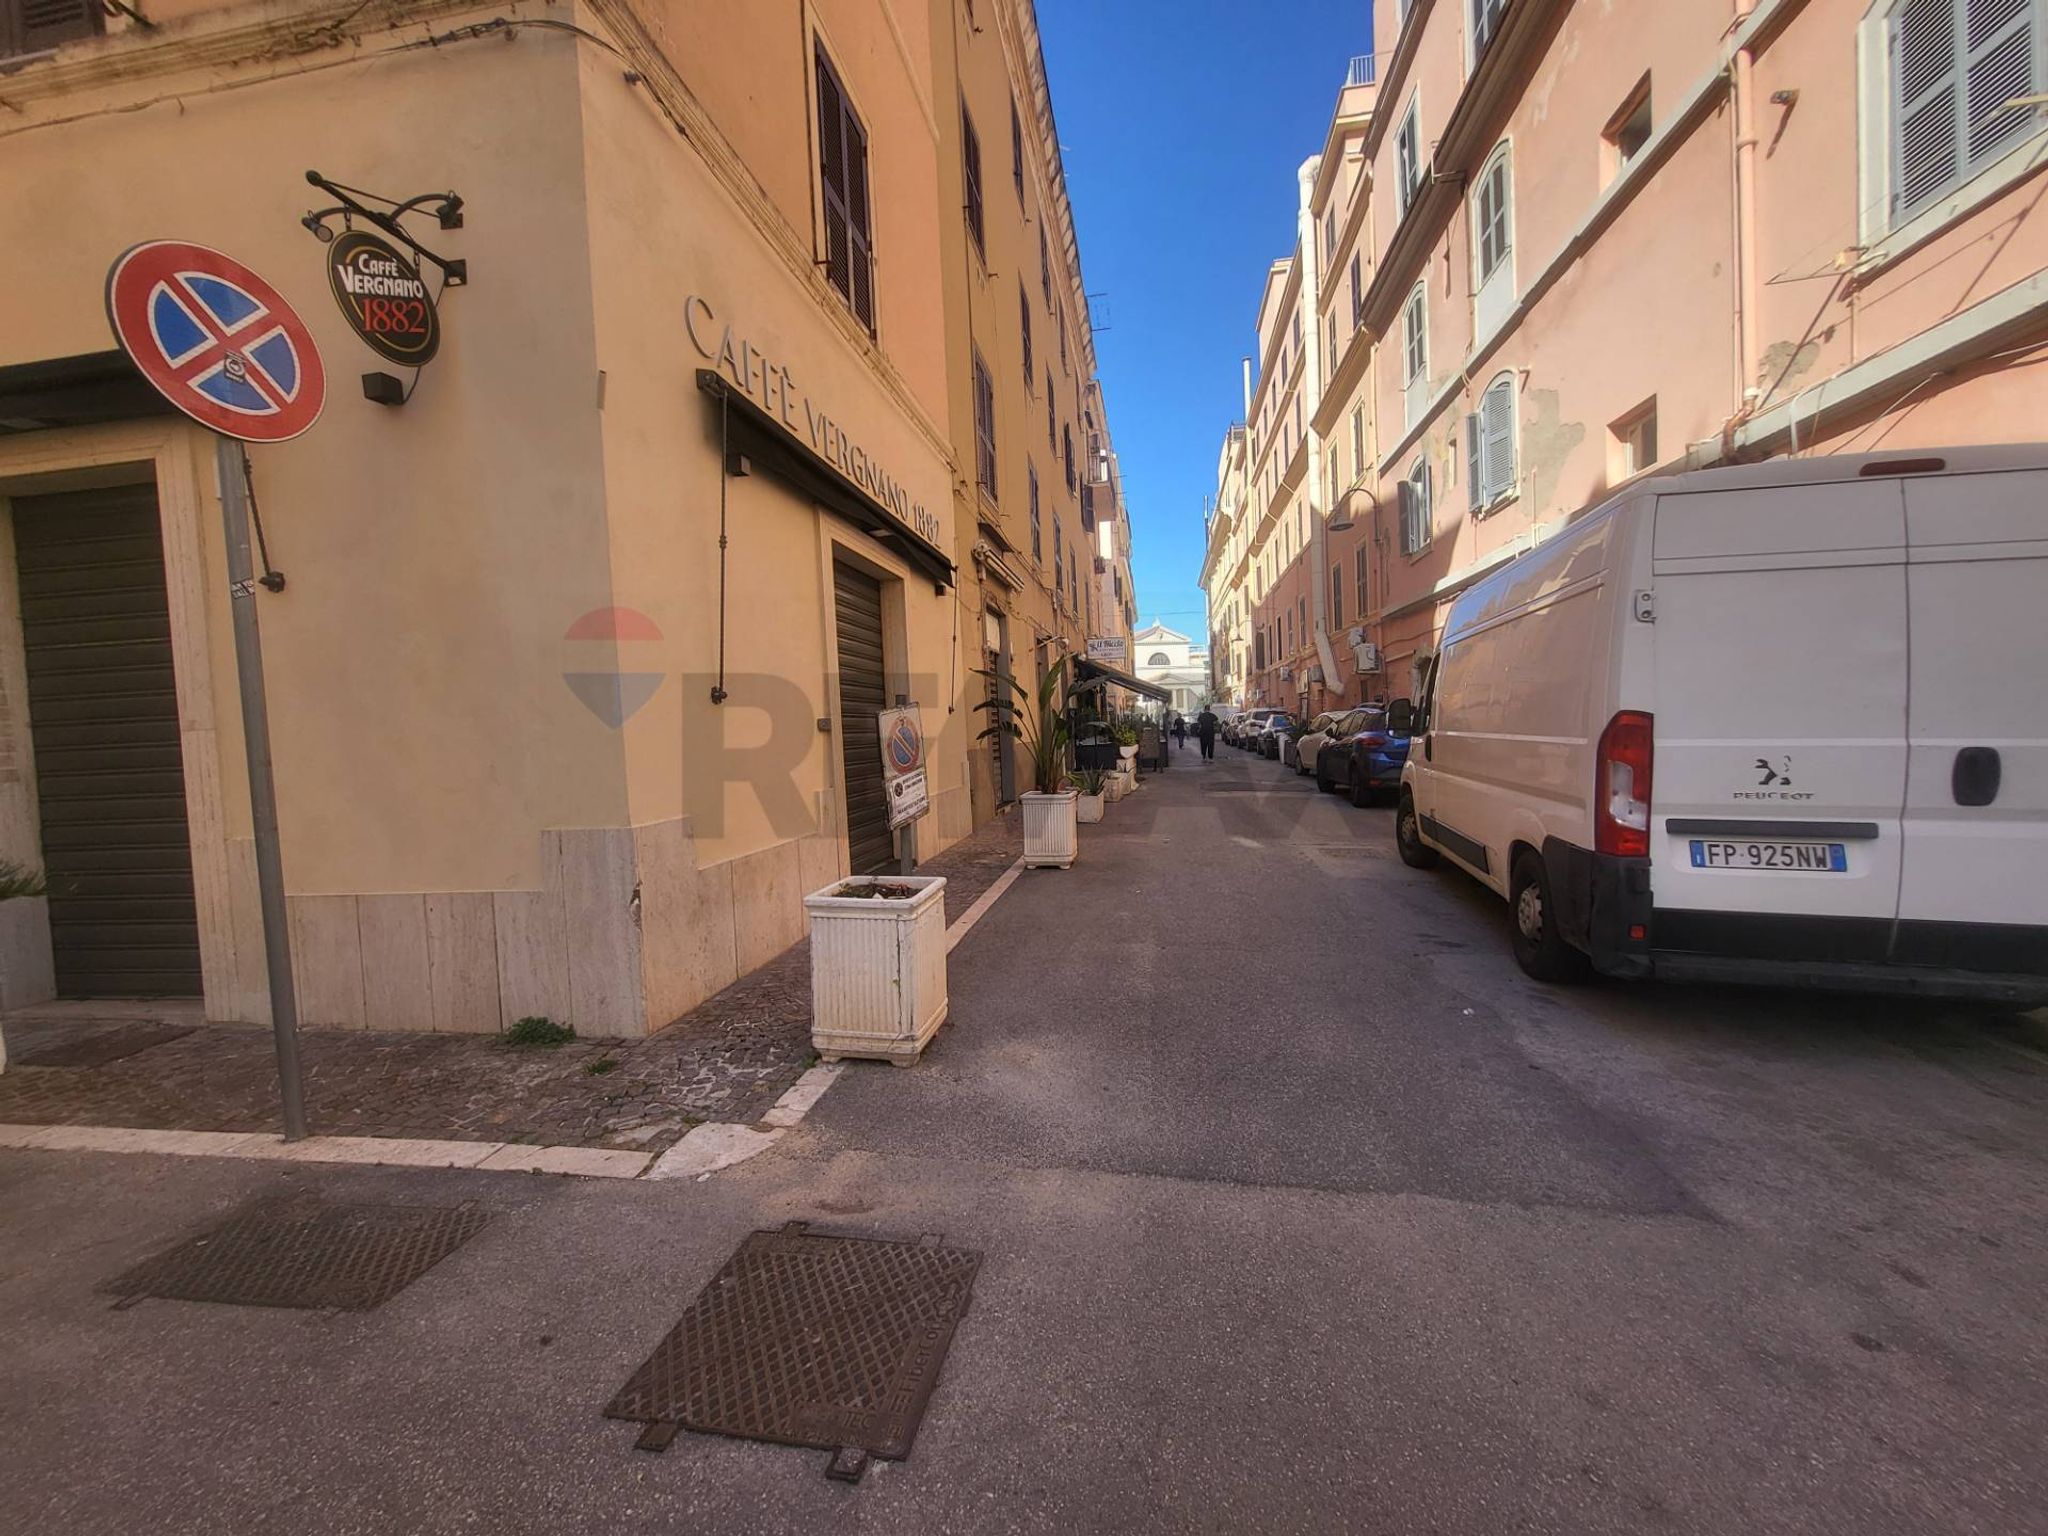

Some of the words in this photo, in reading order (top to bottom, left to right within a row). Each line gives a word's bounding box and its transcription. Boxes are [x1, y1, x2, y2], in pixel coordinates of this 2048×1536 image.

[337, 264, 424, 298] VERGNANO
[363, 298, 425, 333] 1882
[684, 295, 798, 431] CAFFÈ
[804, 398, 909, 521] VERGNANO
[912, 501, 941, 549] 1882
